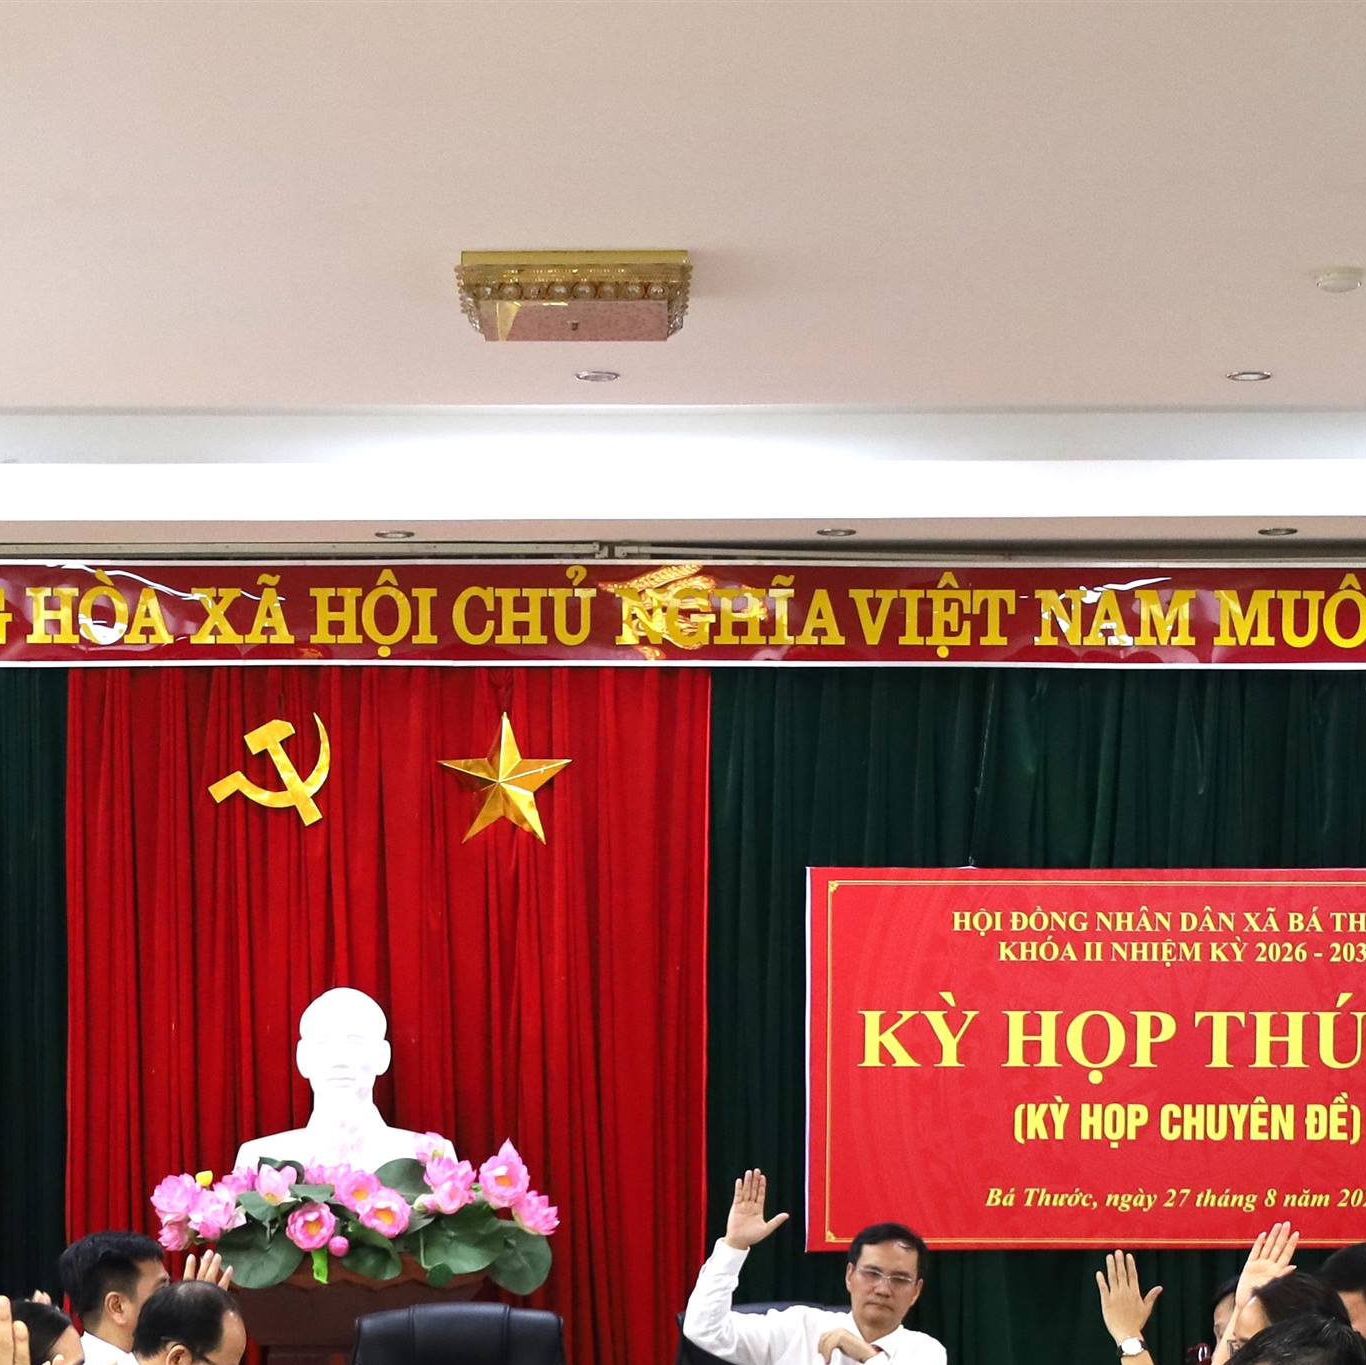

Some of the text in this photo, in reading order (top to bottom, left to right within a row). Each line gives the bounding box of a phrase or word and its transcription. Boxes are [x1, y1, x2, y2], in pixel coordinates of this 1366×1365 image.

[26, 568, 174, 646] HÒA
[190, 573, 295, 645] XÃ
[309, 568, 438, 658] HỘI
[452, 564, 598, 646] CHỦ
[615, 574, 846, 648] NGHĨA
[848, 571, 1016, 659] VIỆT
[1034, 588, 1197, 647] NAM
[952, 907, 1003, 937] HỘI
[1009, 905, 1089, 933] ĐỒNG
[1095, 905, 1172, 933] NHÂN
[1179, 905, 1236, 933] DÂN
[1242, 906, 1281, 933] XÃ
[1287, 906, 1324, 933] BÁ
[998, 935, 1078, 962] KHÓA
[1083, 941, 1104, 962] II
[1110, 938, 1203, 968] NHIỆM
[1209, 935, 1248, 963] KỲ
[1255, 941, 1308, 963] 2026
[857, 991, 980, 1068] KỲ
[1001, 1010, 1177, 1085] HỌP
[1013, 1091, 1361, 1149] (KỲ HỌP CHUYÊN ĐỀ)
[985, 1187, 1016, 1207] Bá
[1024, 1187, 1098, 1210] Thước,
[1105, 1187, 1158, 1213] ngày
[1162, 1188, 1192, 1208] 27
[1195, 1188, 1258, 1213] tháng
[1264, 1188, 1278, 1208] 8
[1282, 1189, 1330, 1208] năm
